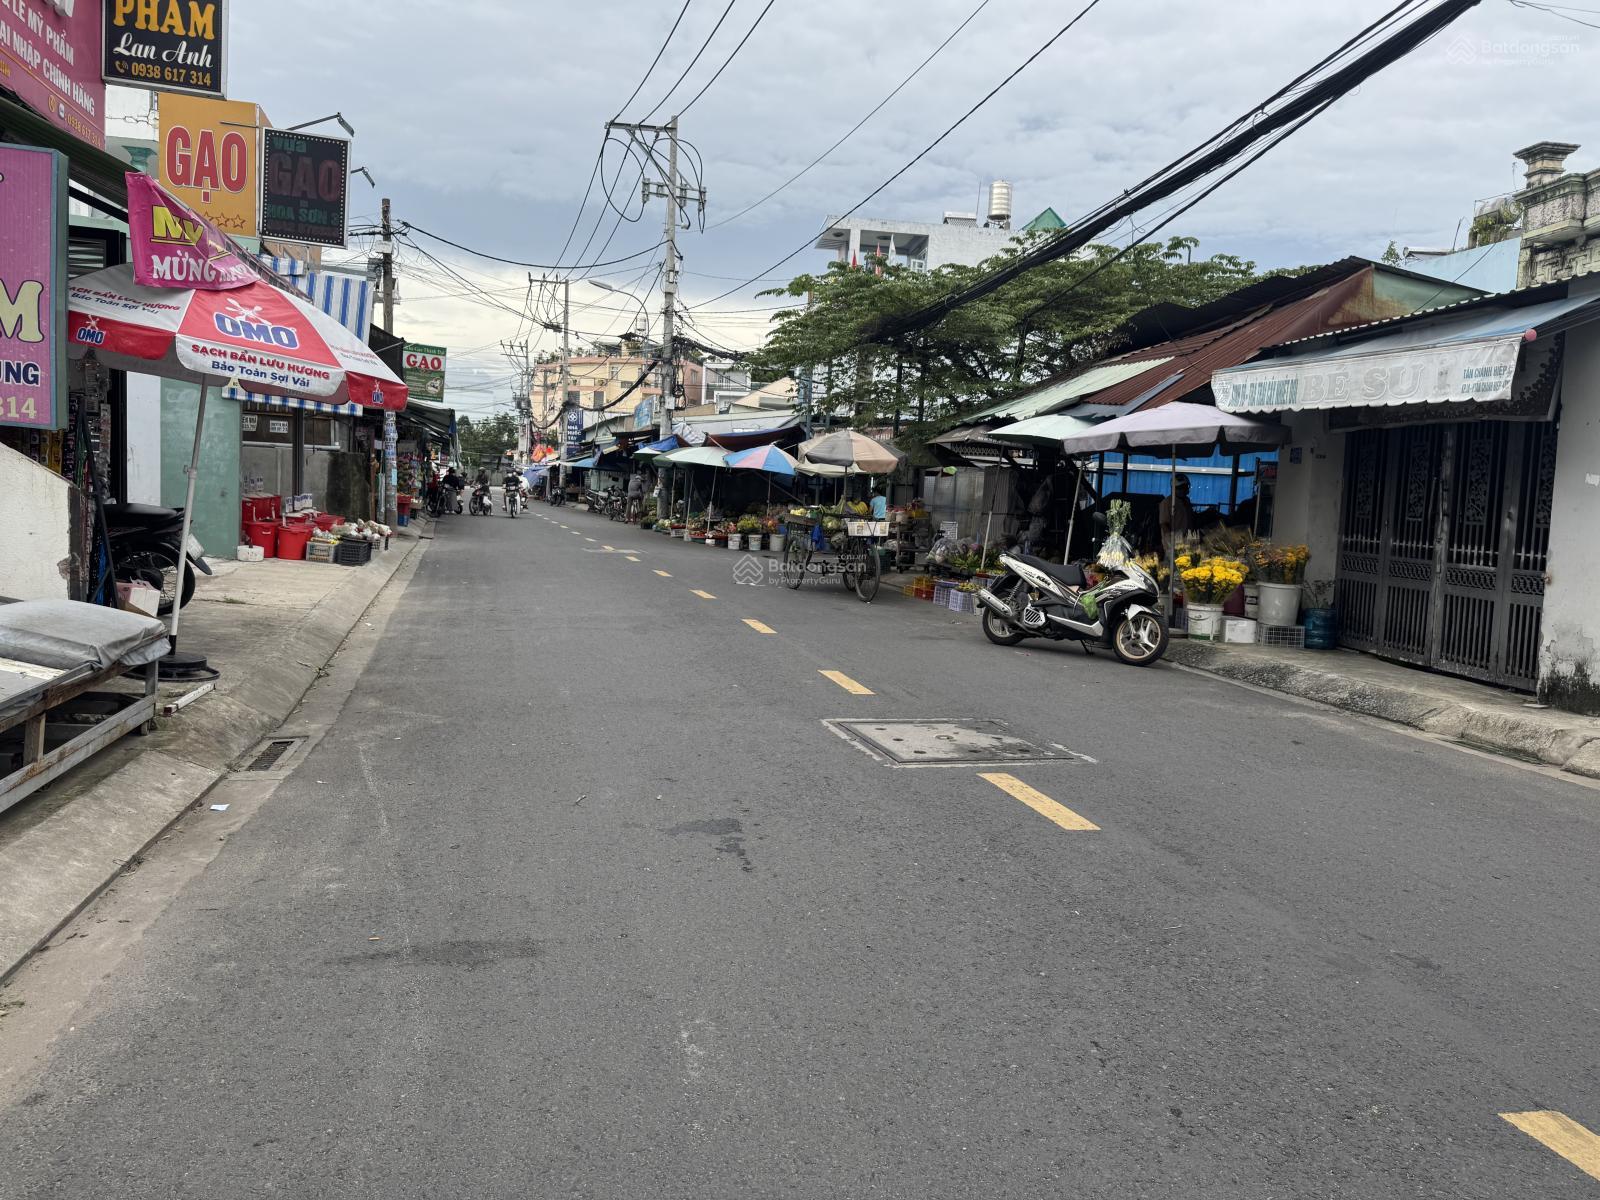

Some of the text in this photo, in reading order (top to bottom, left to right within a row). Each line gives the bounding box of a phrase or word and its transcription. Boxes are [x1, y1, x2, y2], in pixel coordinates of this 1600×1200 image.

[46, 25, 74, 66] PHẨM
[113, 32, 213, 68] Lan Anh
[13, 31, 41, 70] NHẬP
[43, 58, 71, 96] CHÍNH
[73, 82, 95, 118] HÀNG
[131, 62, 211, 87] 0938 617 314
[166, 125, 248, 204] GẠO
[268, 152, 342, 208] GẠO
[151, 249, 217, 282] MỪNG
[76, 327, 105, 345] OMO
[213, 312, 299, 350] OMO
[0, 360, 40, 387] NG
[191, 344, 330, 380] SẠCH BẨN LƯU HƯƠNG
[211, 361, 310, 388] Bảo Toàn Sợi Vải
